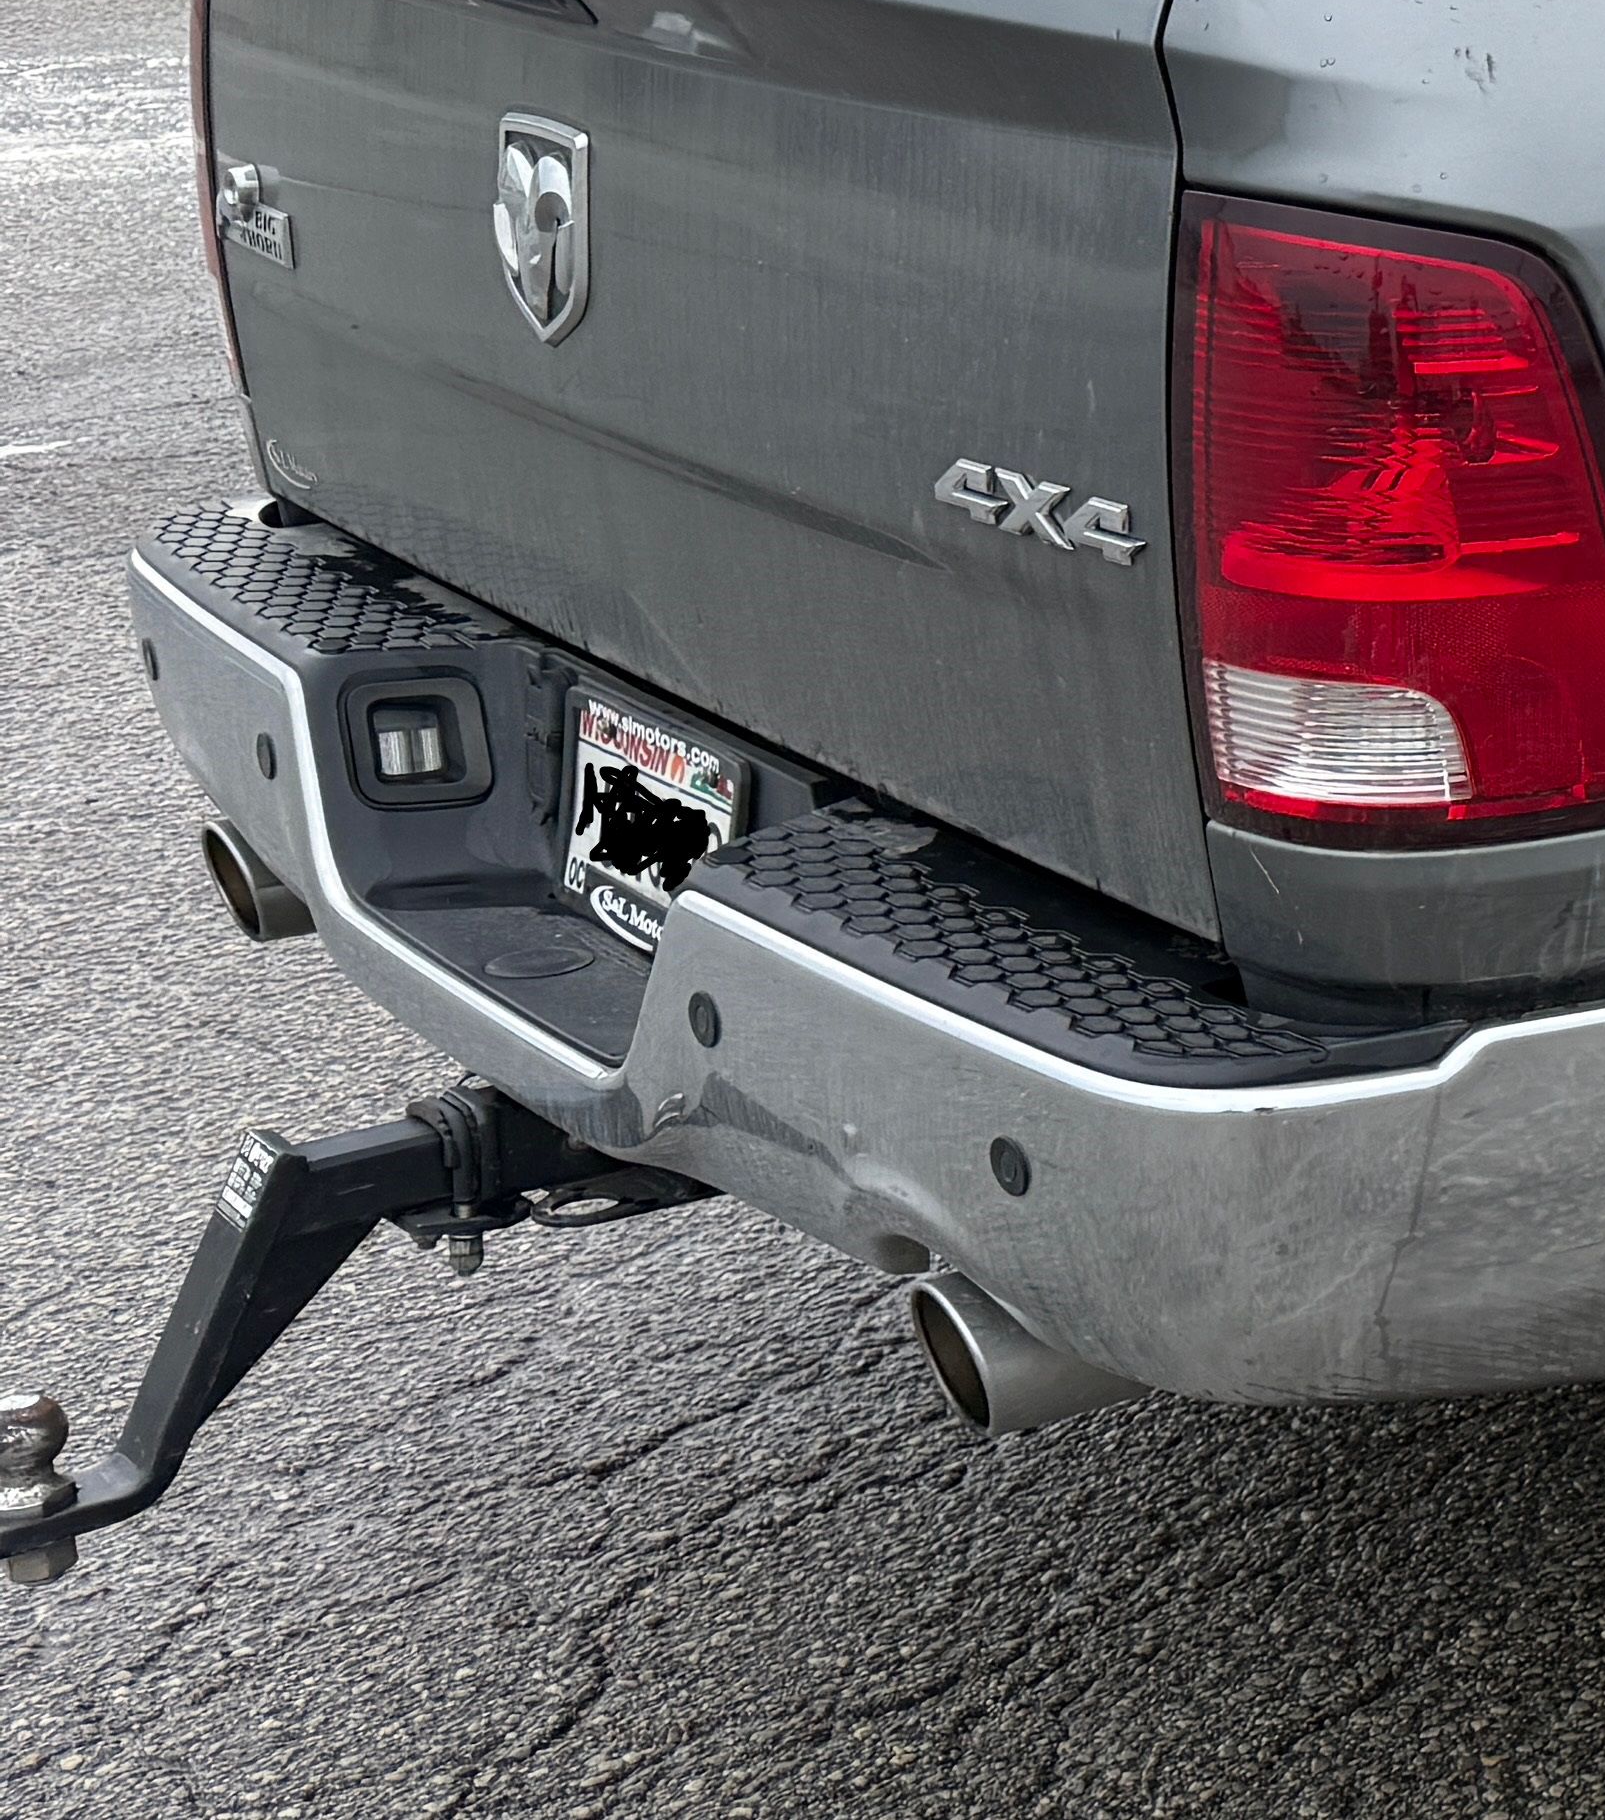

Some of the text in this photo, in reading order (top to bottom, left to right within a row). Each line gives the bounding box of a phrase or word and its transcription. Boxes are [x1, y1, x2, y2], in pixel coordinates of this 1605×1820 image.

[255, 210, 276, 235] BIG
[243, 227, 283, 260] HORN
[588, 699, 720, 773] www.slmotors.com
